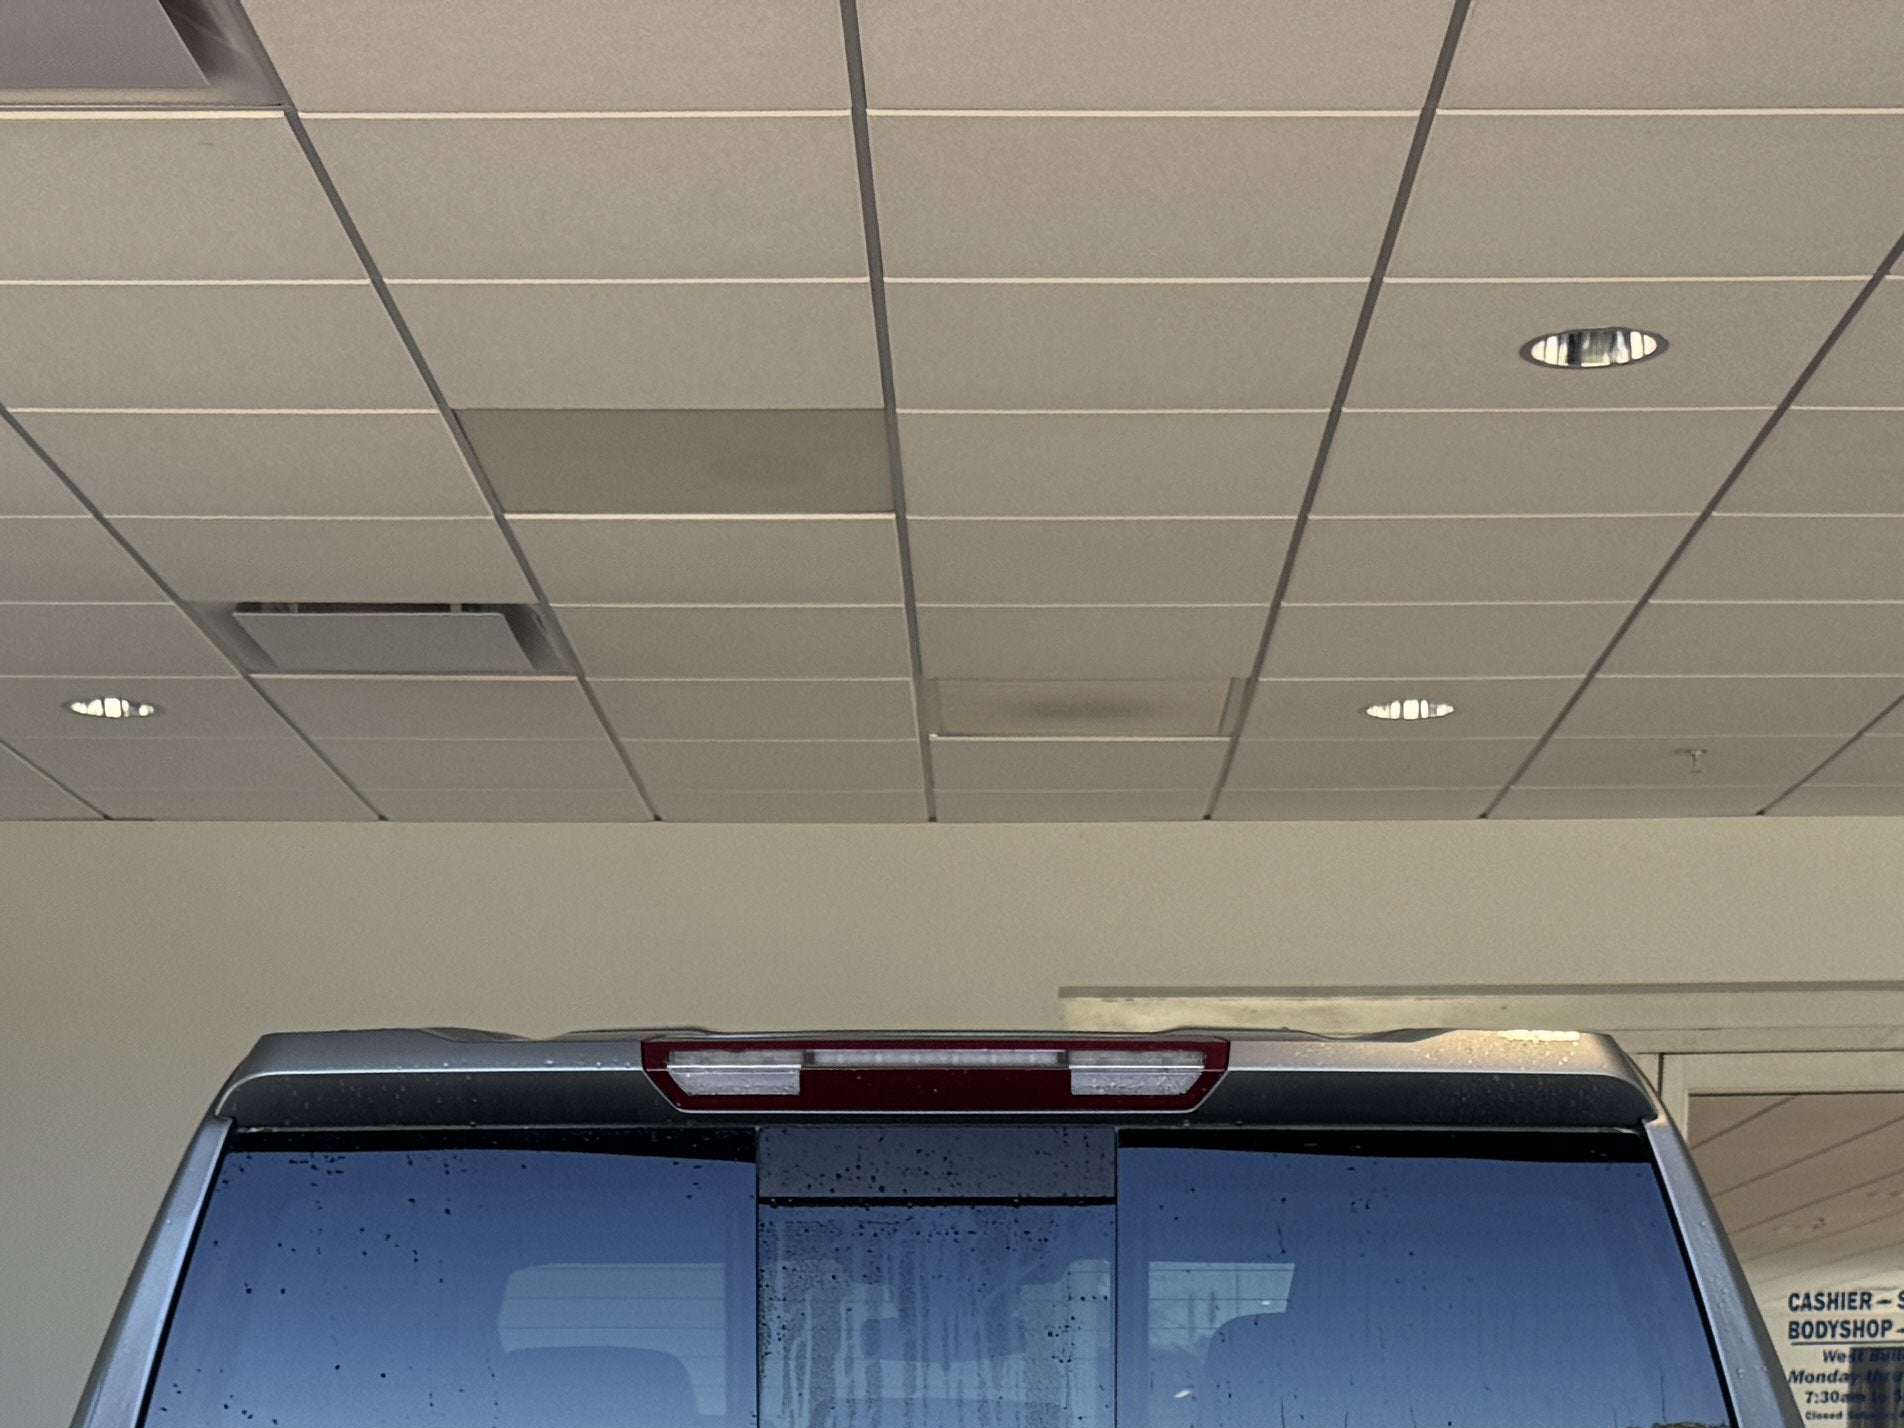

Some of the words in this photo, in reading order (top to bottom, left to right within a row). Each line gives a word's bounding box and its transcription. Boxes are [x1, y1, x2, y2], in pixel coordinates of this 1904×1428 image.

[1788, 1291, 1872, 1312] CASHIER
[1788, 1319, 1893, 1340] BODYSHOP
[1822, 1349, 1863, 1363] West
[1788, 1369, 1860, 1386] Monday
[1805, 1410, 1843, 1420] Closed
